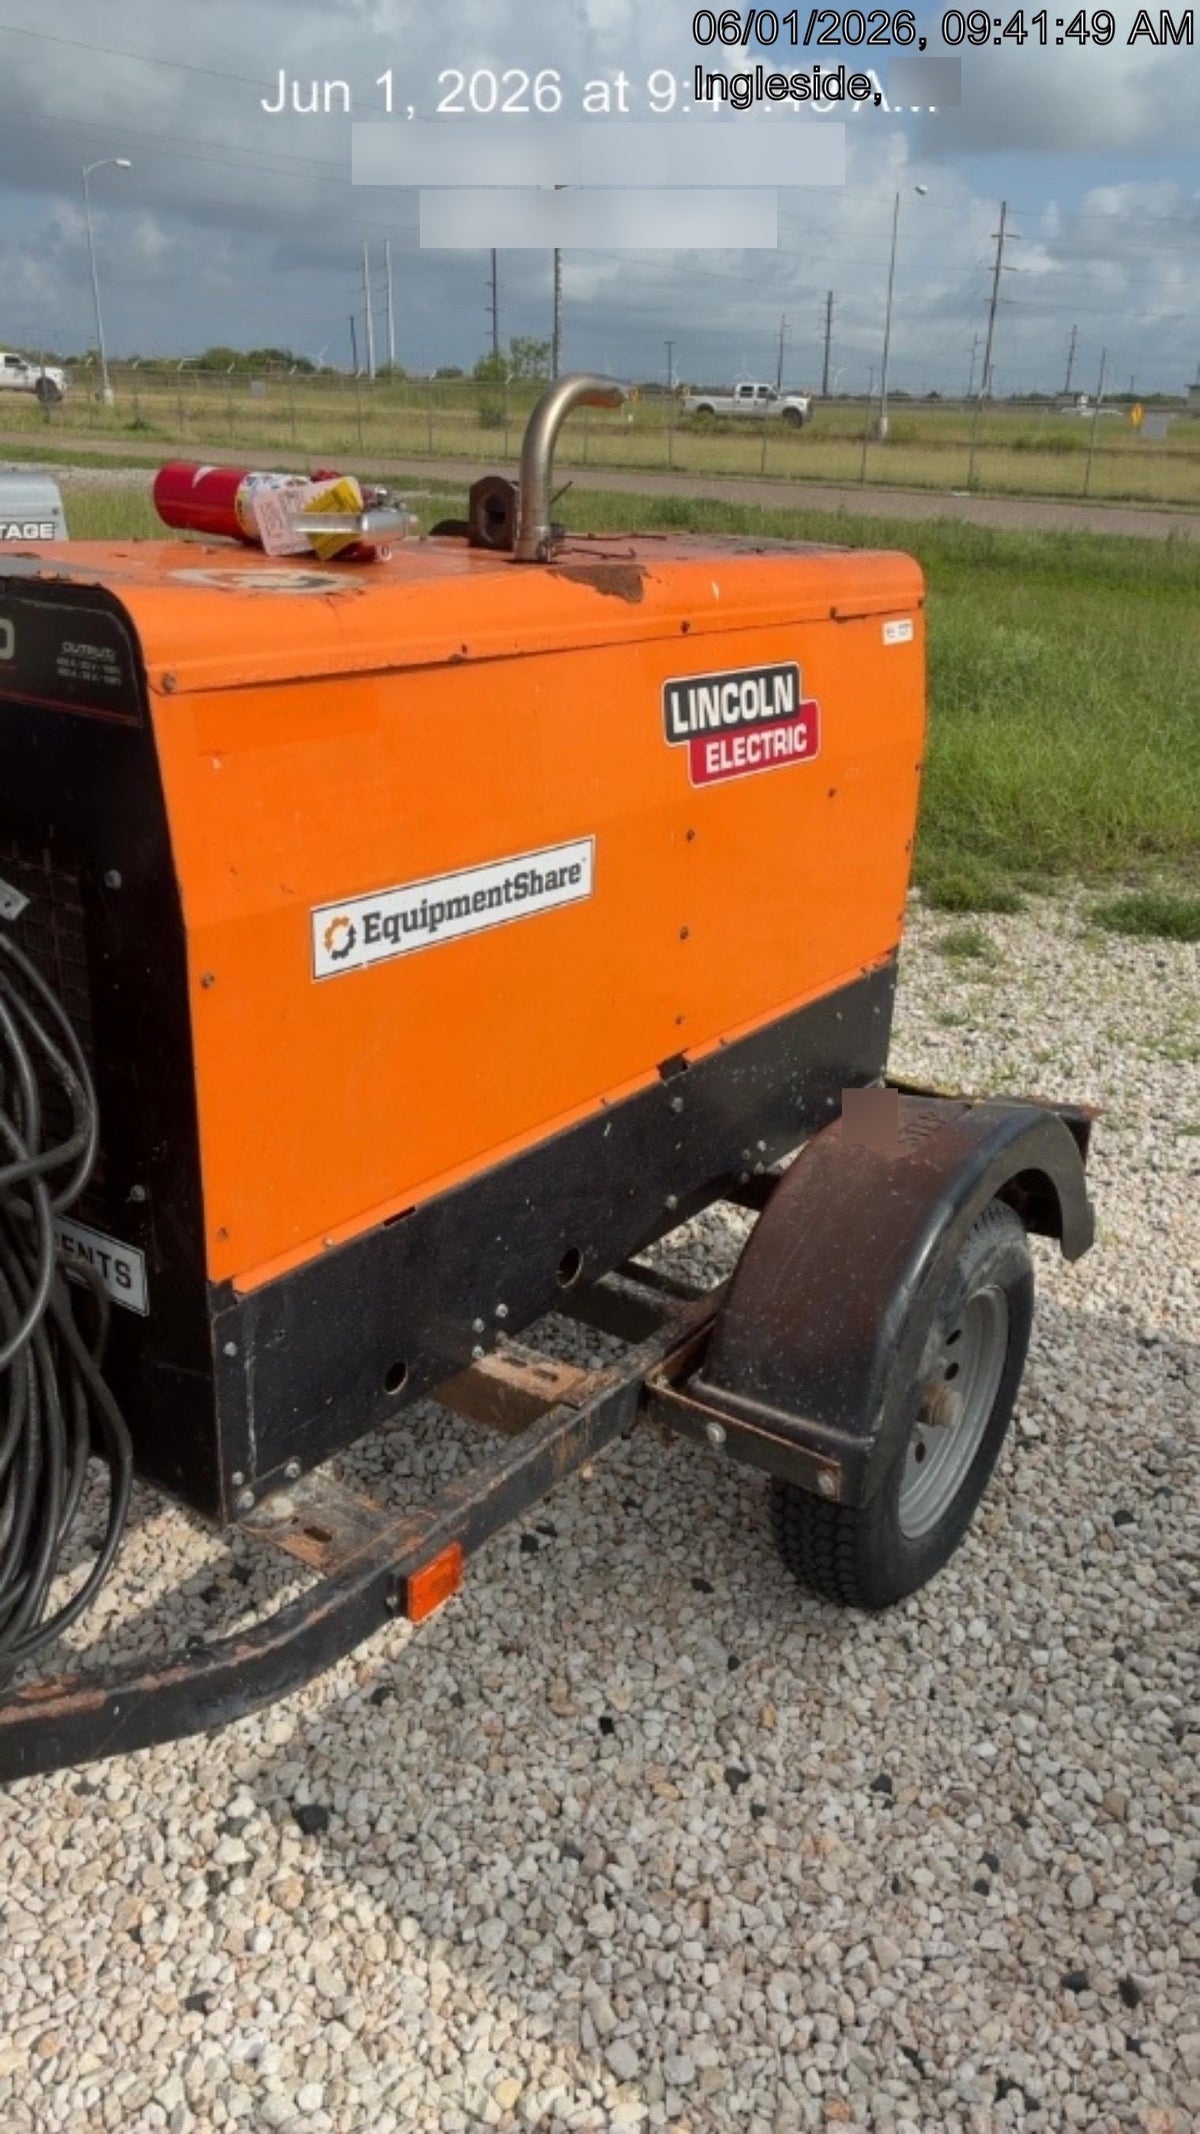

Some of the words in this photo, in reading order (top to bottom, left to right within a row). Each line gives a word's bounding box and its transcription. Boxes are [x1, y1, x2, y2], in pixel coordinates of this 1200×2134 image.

[670, 673, 794, 734] LINCOLN
[705, 722, 808, 774] ELECTRIC
[362, 862, 583, 945] EquipmentShare
